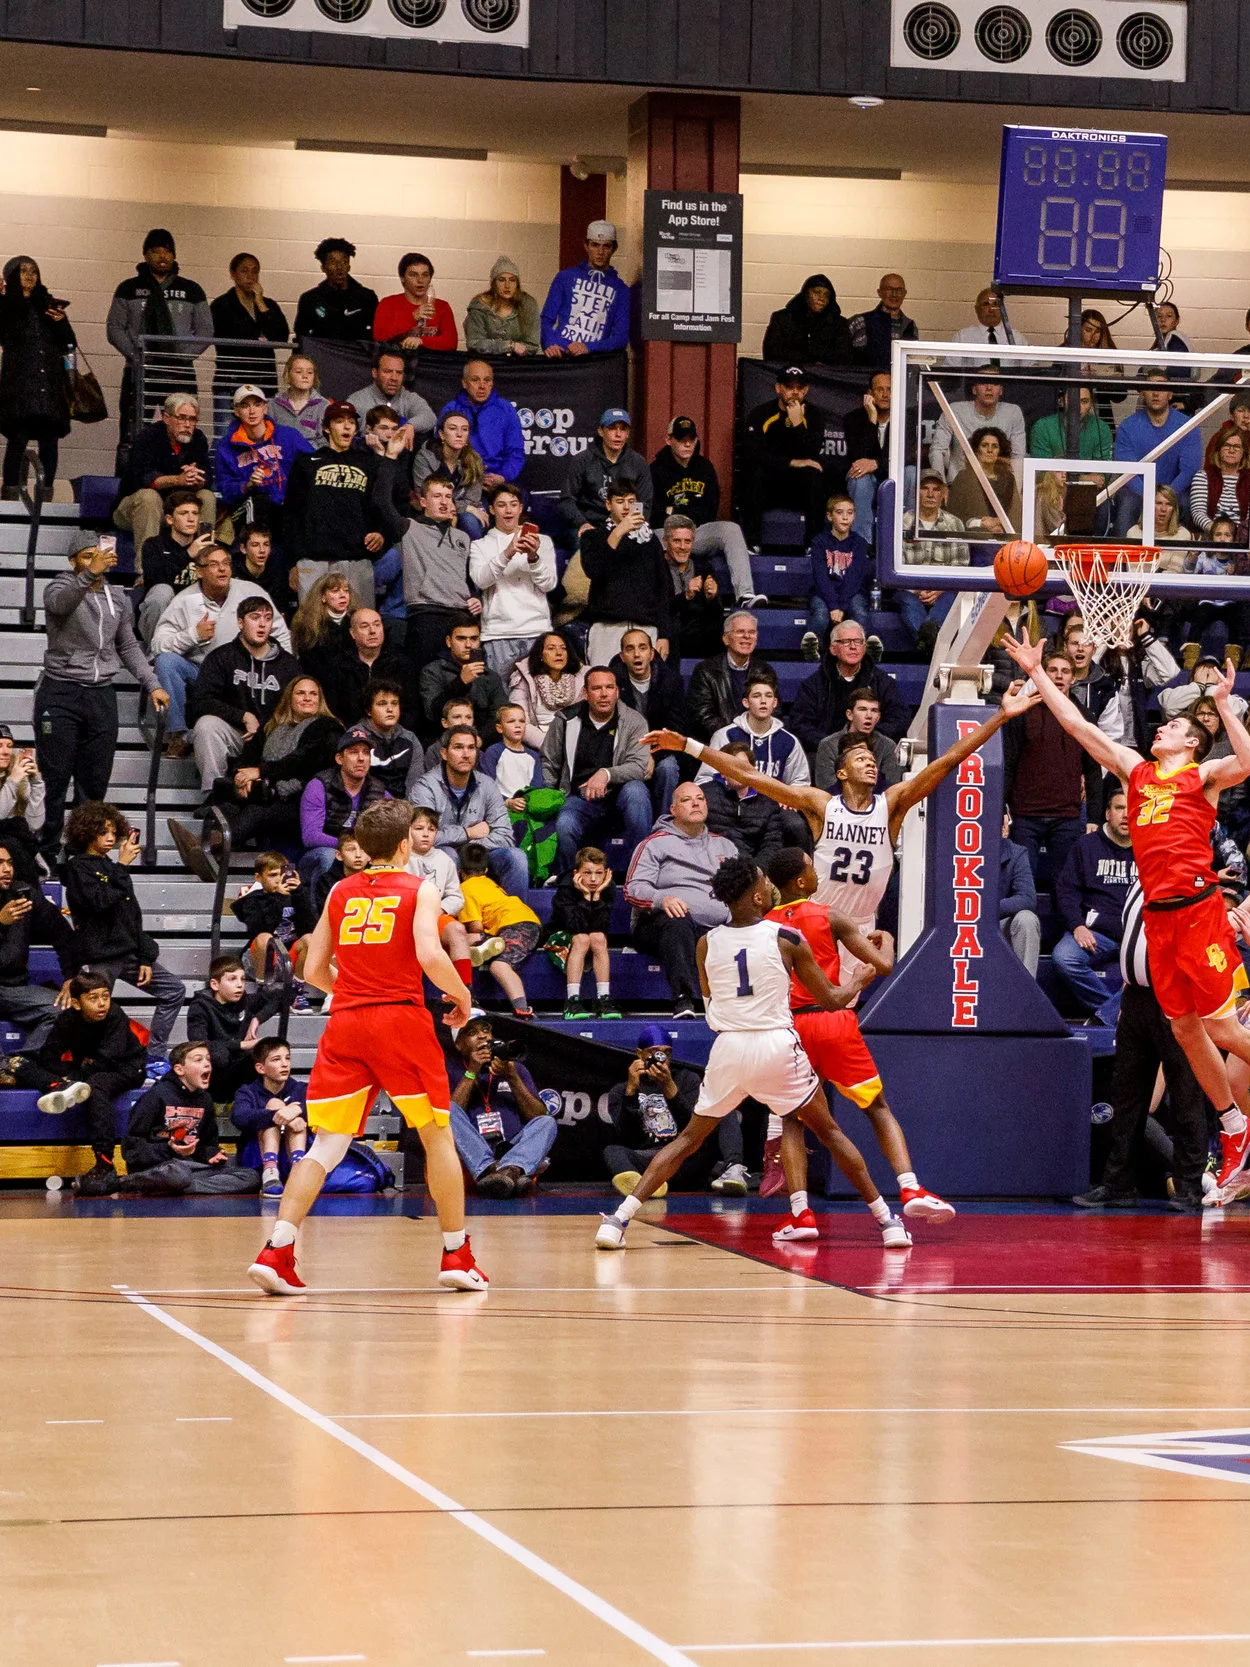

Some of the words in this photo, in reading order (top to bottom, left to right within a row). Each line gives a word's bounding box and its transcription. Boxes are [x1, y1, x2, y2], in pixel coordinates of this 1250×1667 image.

[1051, 131, 1127, 143] DAKTRONICS
[661, 199, 683, 211] Find
[685, 202, 697, 211] us
[699, 201, 709, 212] in
[711, 202, 727, 212] the
[668, 214, 689, 227] App
[690, 215, 720, 226] Store!
[671, 314, 690, 322] Camp
[691, 314, 704, 322] and
[721, 315, 735, 323] Fest
[673, 323, 712, 331] Information
[511, 401, 574, 433] oop
[233, 669, 280, 691] FILA
[1136, 794, 1175, 827] 32
[826, 821, 887, 845] RANNEY
[829, 846, 874, 885] 23
[950, 719, 985, 1027] BROOKDALE
[1096, 858, 1127, 877] NOTRE
[338, 895, 402, 947] 25
[734, 948, 754, 997] 1
